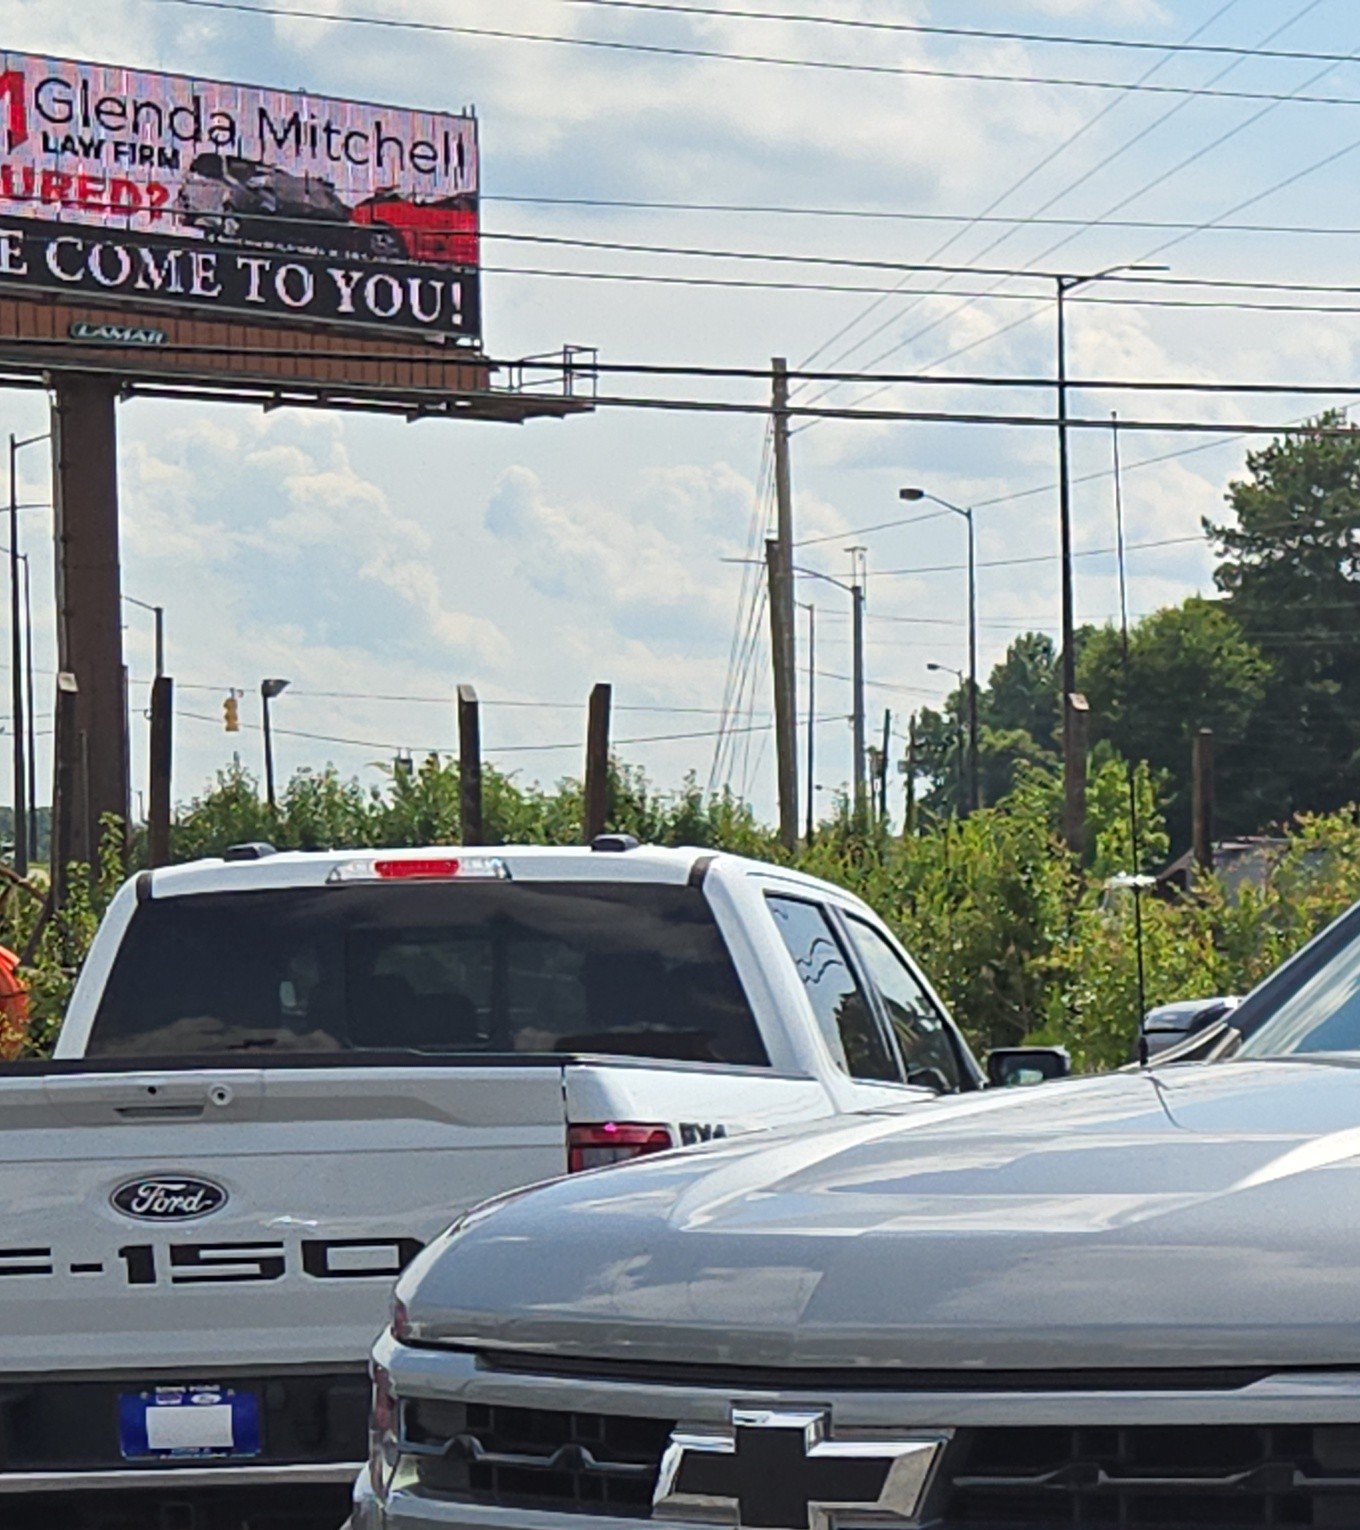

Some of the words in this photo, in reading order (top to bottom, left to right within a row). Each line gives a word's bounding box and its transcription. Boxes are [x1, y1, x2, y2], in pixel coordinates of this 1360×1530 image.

[35, 77, 237, 148] Glenda
[258, 106, 465, 180] Mitchell
[42, 130, 105, 160] LAW
[114, 140, 180, 169] FIRM
[46, 235, 223, 298] COME
[237, 257, 314, 308] TO
[327, 267, 463, 325] YOU!
[130, 1182, 213, 1214] Ford
